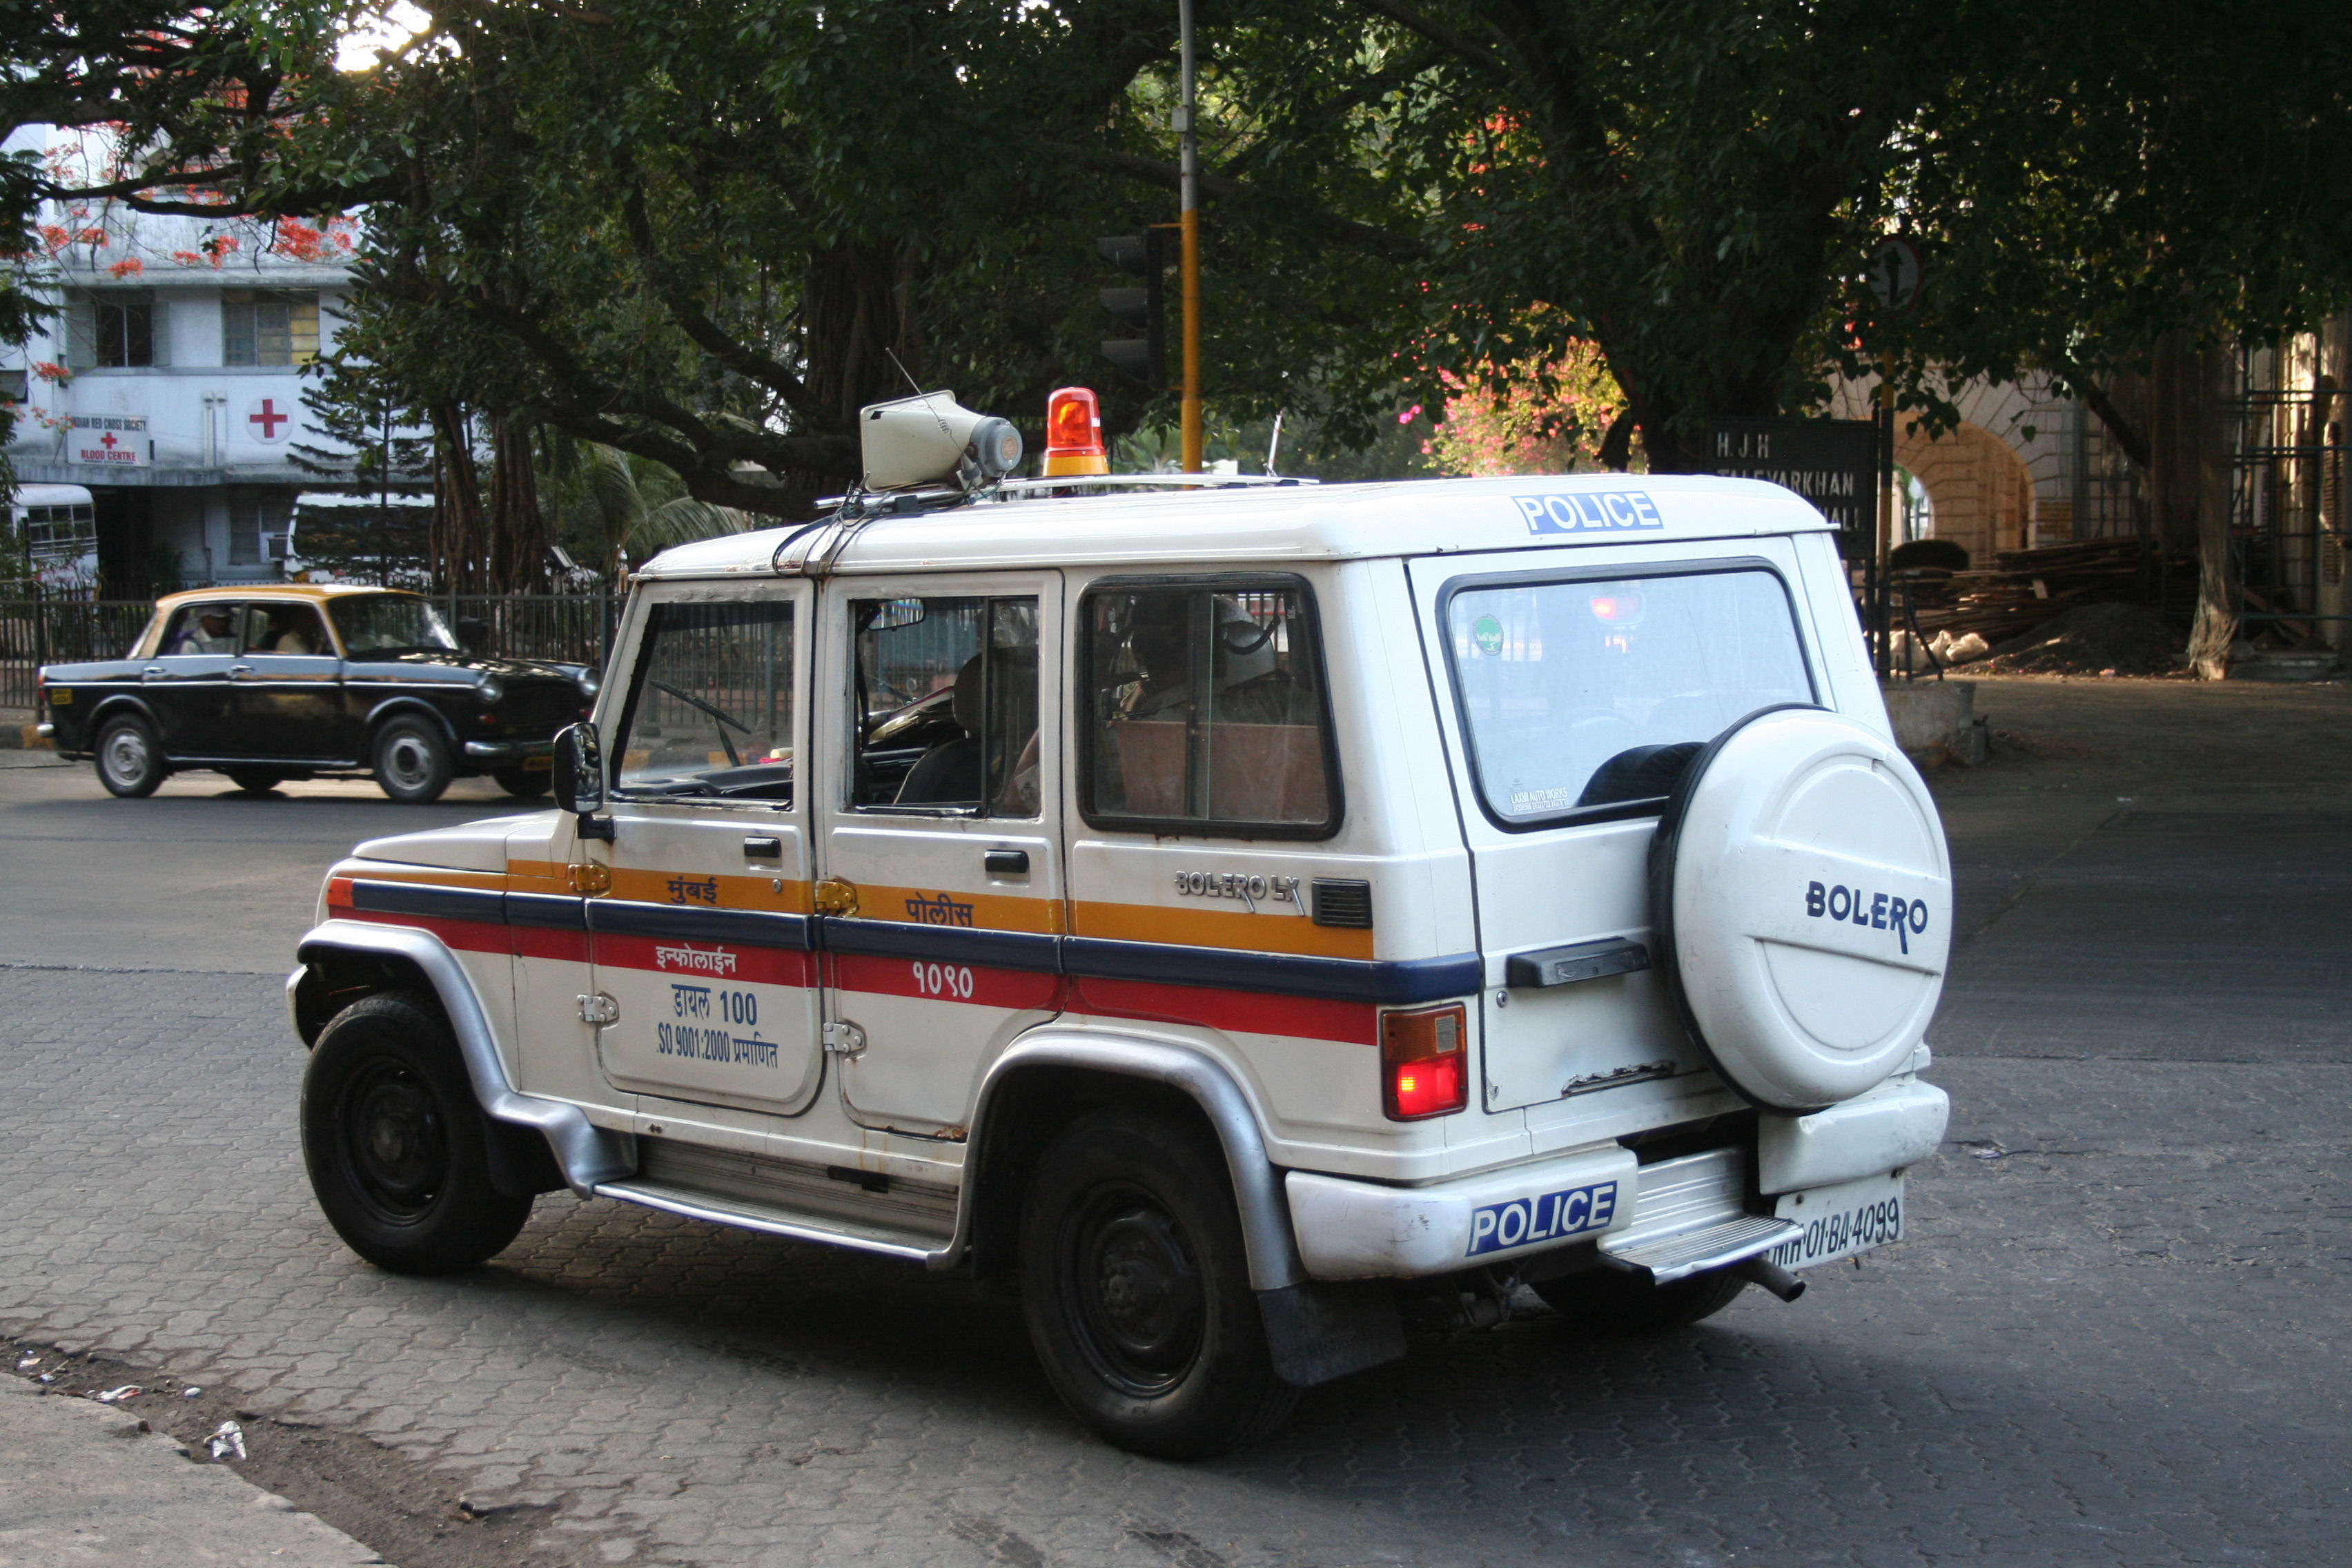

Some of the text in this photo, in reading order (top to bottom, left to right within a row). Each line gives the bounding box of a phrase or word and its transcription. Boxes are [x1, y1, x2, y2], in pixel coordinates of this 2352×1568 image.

[92, 418, 102, 429] RED
[104, 418, 122, 430] CROSS
[124, 420, 146, 431] SOCIETY
[81, 450, 136, 461] BLOOD CENTRE
[1716, 469, 1854, 496] YARKHAN
[1514, 493, 1660, 531] POLICE
[1529, 790, 1545, 803] AUTO
[1545, 787, 1568, 801] WORKS
[667, 876, 718, 904] मुंबई
[1174, 870, 1305, 917] BOLERO LX
[905, 892, 974, 928] पोलीस
[1805, 881, 1928, 954] BOLERO
[671, 983, 758, 1026] डायल 100
[676, 1026, 730, 1063] 9001:2000
[1469, 1184, 1614, 1253] POLICE
